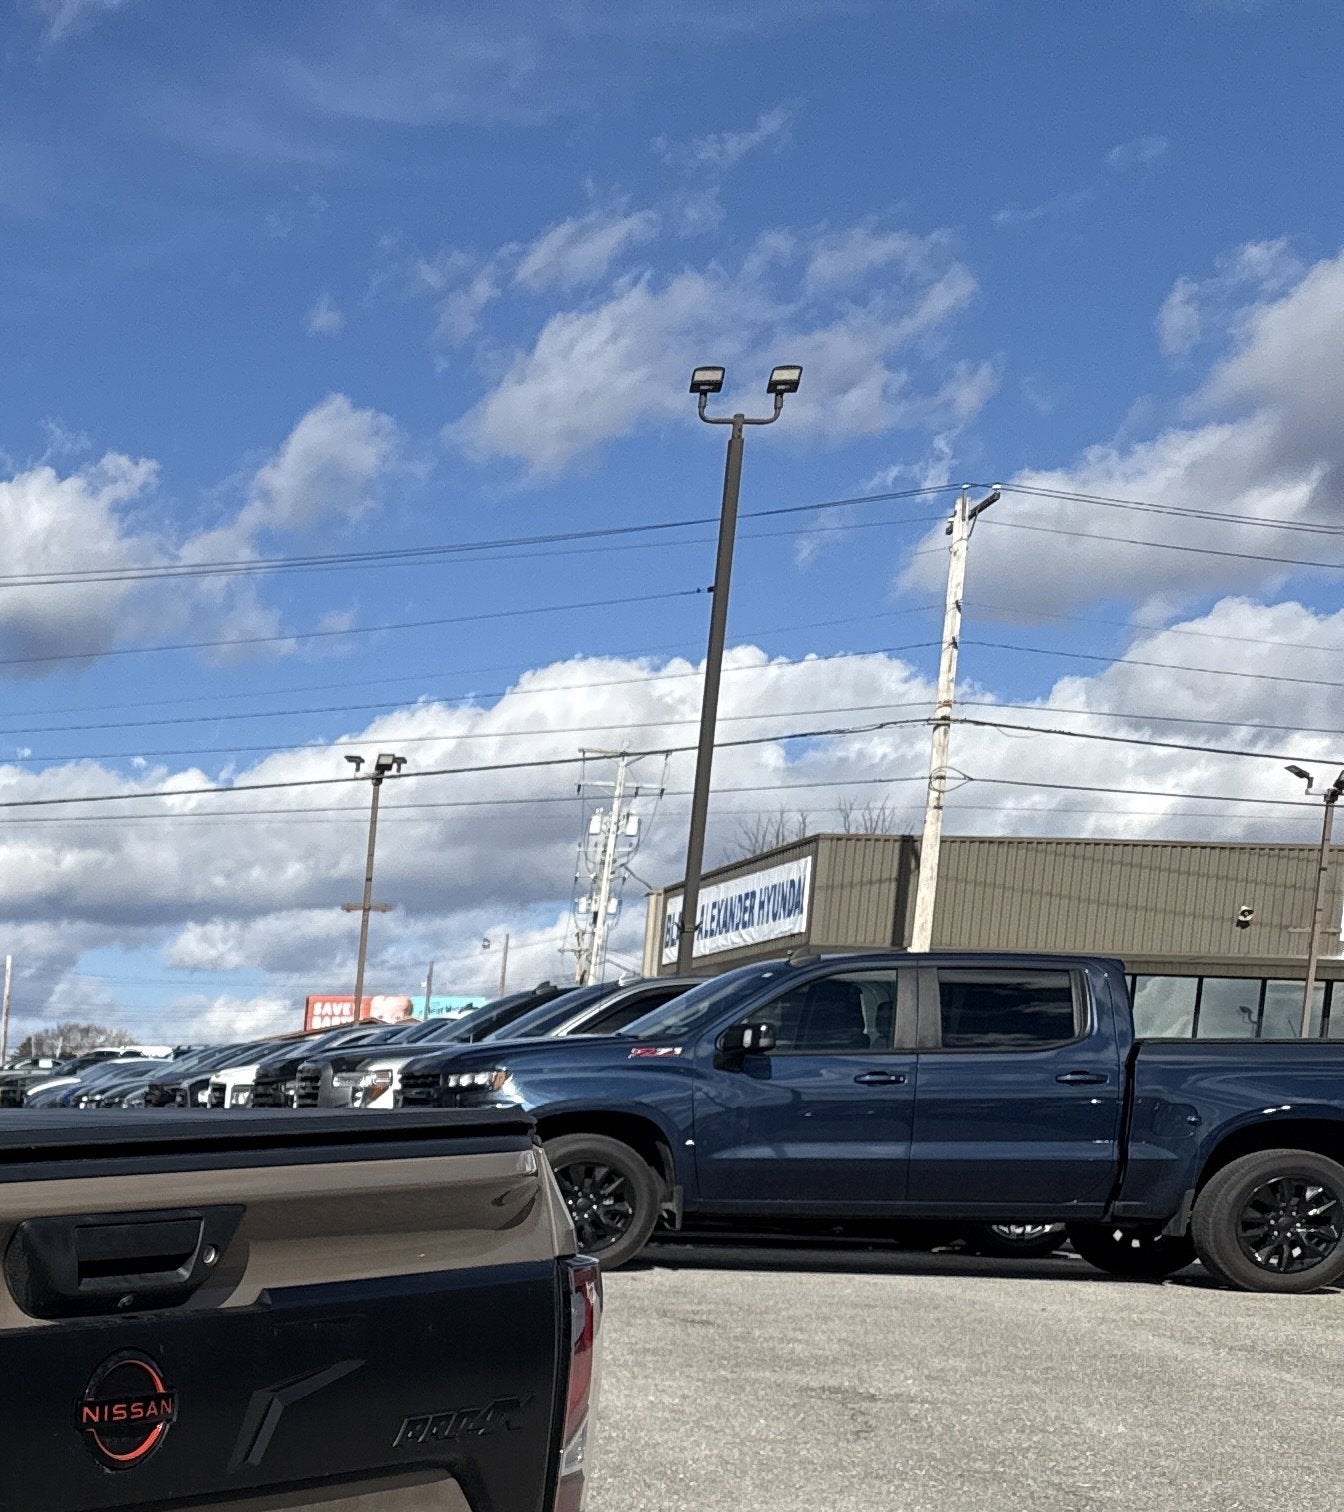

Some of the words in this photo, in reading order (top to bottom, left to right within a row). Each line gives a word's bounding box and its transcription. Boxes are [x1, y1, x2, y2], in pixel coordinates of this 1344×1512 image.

[696, 889, 756, 941] ALEXANDER
[313, 1002, 352, 1016] SAVE
[81, 1398, 173, 1424] NISSAN
